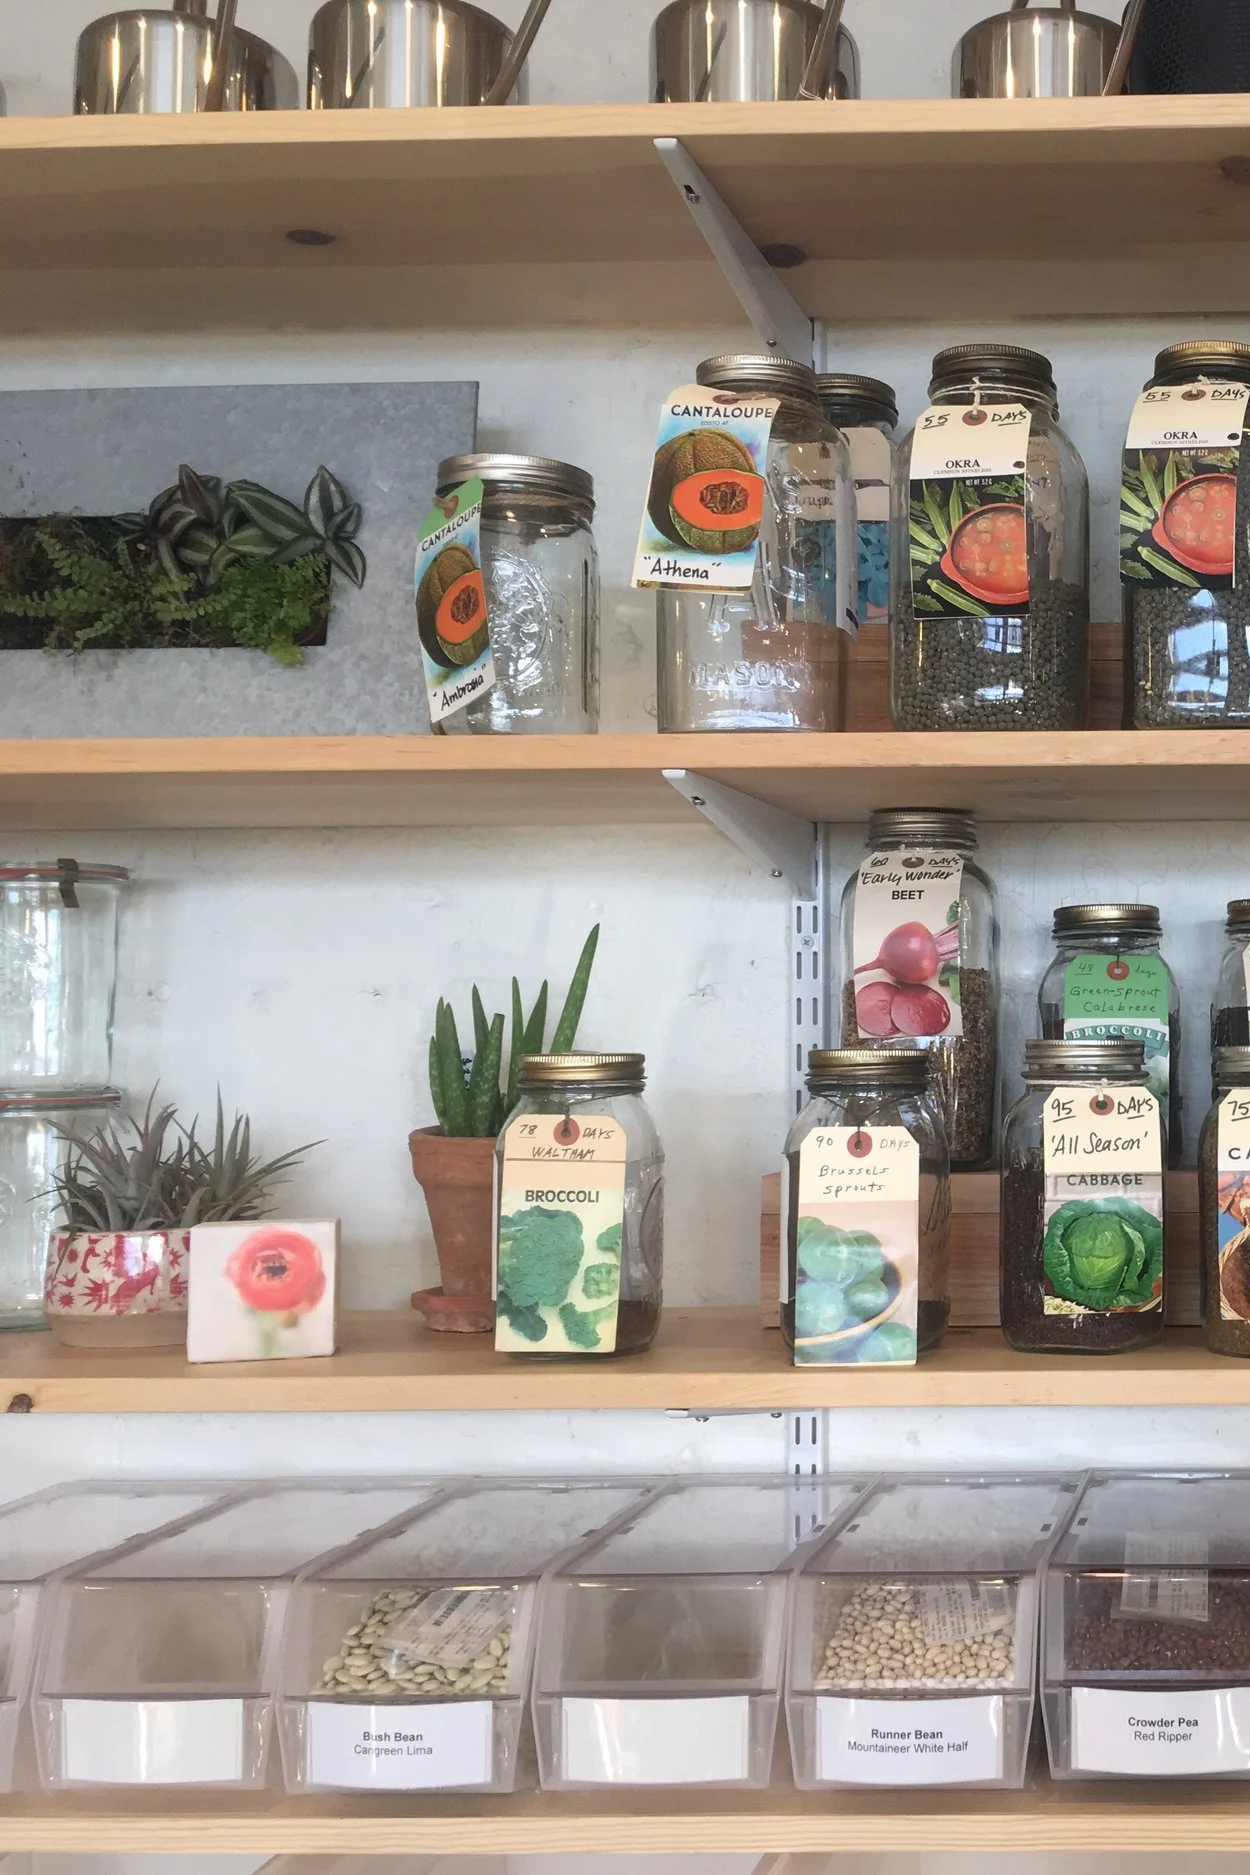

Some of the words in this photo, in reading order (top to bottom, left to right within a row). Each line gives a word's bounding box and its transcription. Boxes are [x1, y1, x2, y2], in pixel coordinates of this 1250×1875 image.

[1143, 391, 1171, 402] 55
[1210, 388, 1247, 401] DAYS
[671, 404, 773, 418] CANTALOUPE
[922, 414, 951, 429] 55
[991, 410, 1028, 426] DAYS
[1163, 431, 1198, 440] OKRA
[945, 459, 981, 469] OKRA
[421, 502, 481, 552] CANTALOUPE
[927, 856, 960, 868] DAYS
[891, 890, 925, 900] BEET
[1070, 1025, 1163, 1041] BROCCOLI
[1051, 1098, 1077, 1122] 95
[1117, 1096, 1154, 1119] DAYS
[519, 1124, 538, 1138] 78
[581, 1127, 615, 1140] DAYS
[815, 1135, 834, 1148] 90
[531, 1146, 595, 1160] WALTHAM
[818, 1165, 890, 1178] Brussels
[1066, 1173, 1144, 1186] CABBAGE
[525, 1190, 600, 1204] BROCCOLI
[1128, 1717, 1175, 1728] Crowder
[1178, 1717, 1199, 1728] Pea
[363, 1731, 391, 1742] Bush
[394, 1732, 423, 1742] Bean
[871, 1728, 911, 1740] Runner
[914, 1729, 943, 1740] Bean
[1134, 1730, 1156, 1741] Red
[1158, 1731, 1193, 1744] Ripper
[406, 1745, 434, 1755] Lima
[847, 1741, 910, 1753] Mountaineer
[913, 1743, 944, 1753] White
[947, 1741, 969, 1752] Half
